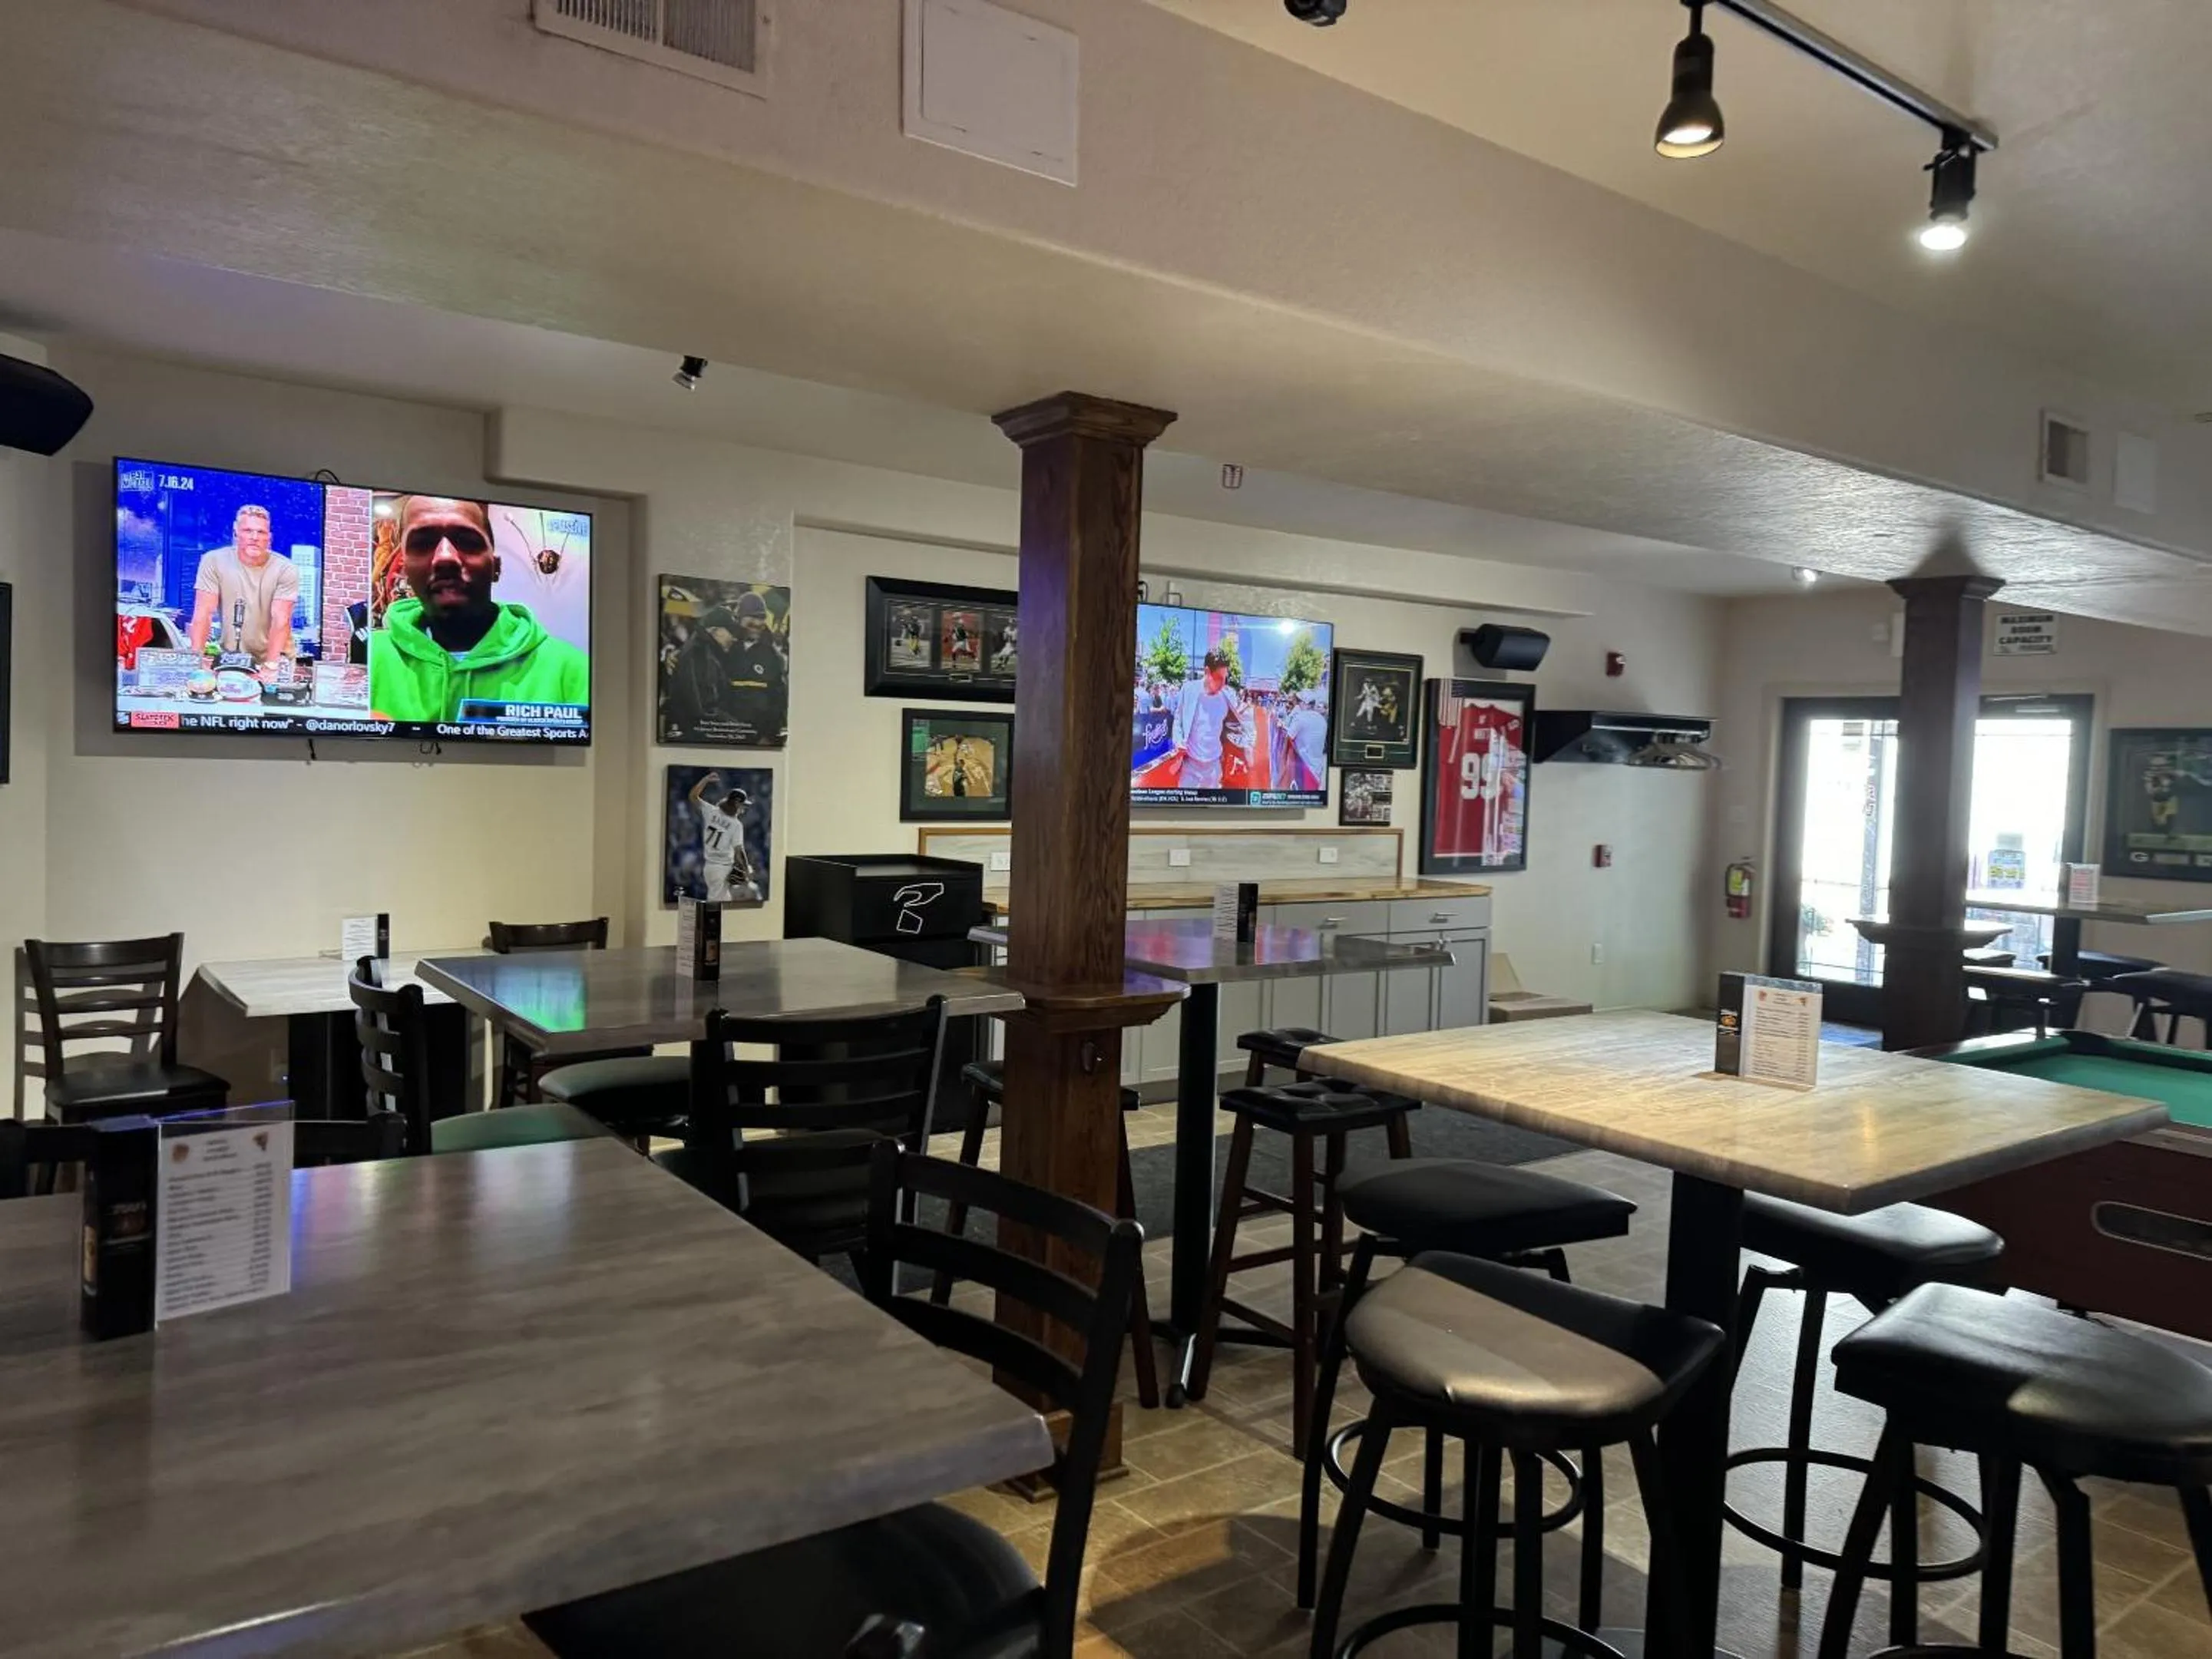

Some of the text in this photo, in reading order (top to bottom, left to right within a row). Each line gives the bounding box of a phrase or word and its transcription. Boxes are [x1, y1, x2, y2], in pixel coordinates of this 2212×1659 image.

[157, 474, 194, 491] 7.16.24
[504, 704, 583, 719] RICH PAUL
[200, 715, 226, 727] NFL
[228, 716, 260, 730] right
[436, 723, 461, 735] One
[463, 724, 474, 735] of
[477, 725, 494, 736] the
[497, 725, 541, 737] Greatest
[544, 727, 577, 739] Sports
[705, 825, 726, 850] 71
